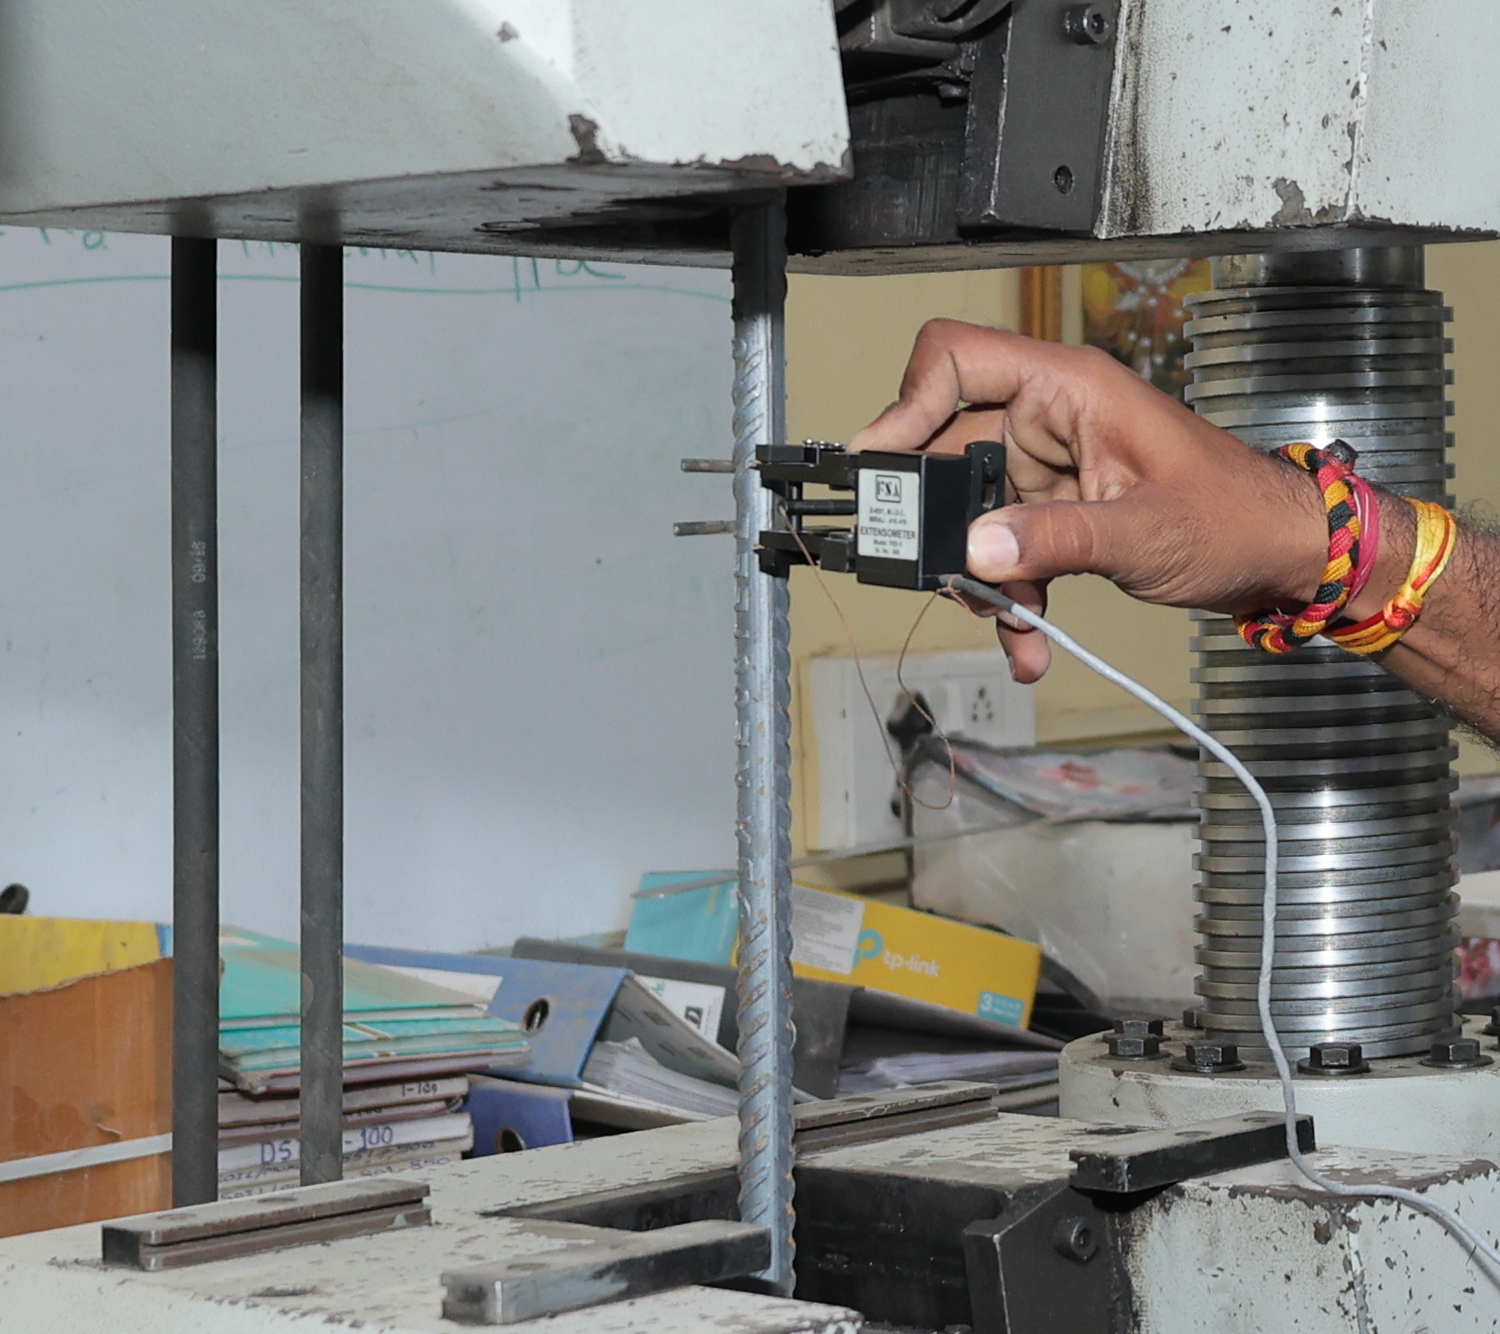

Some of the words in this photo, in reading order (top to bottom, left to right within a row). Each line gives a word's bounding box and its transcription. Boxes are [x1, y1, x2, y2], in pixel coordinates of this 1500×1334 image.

[860, 526, 916, 539] EXTENSOMETER
[884, 950, 940, 978] tp-link
[980, 994, 994, 1012] 3
